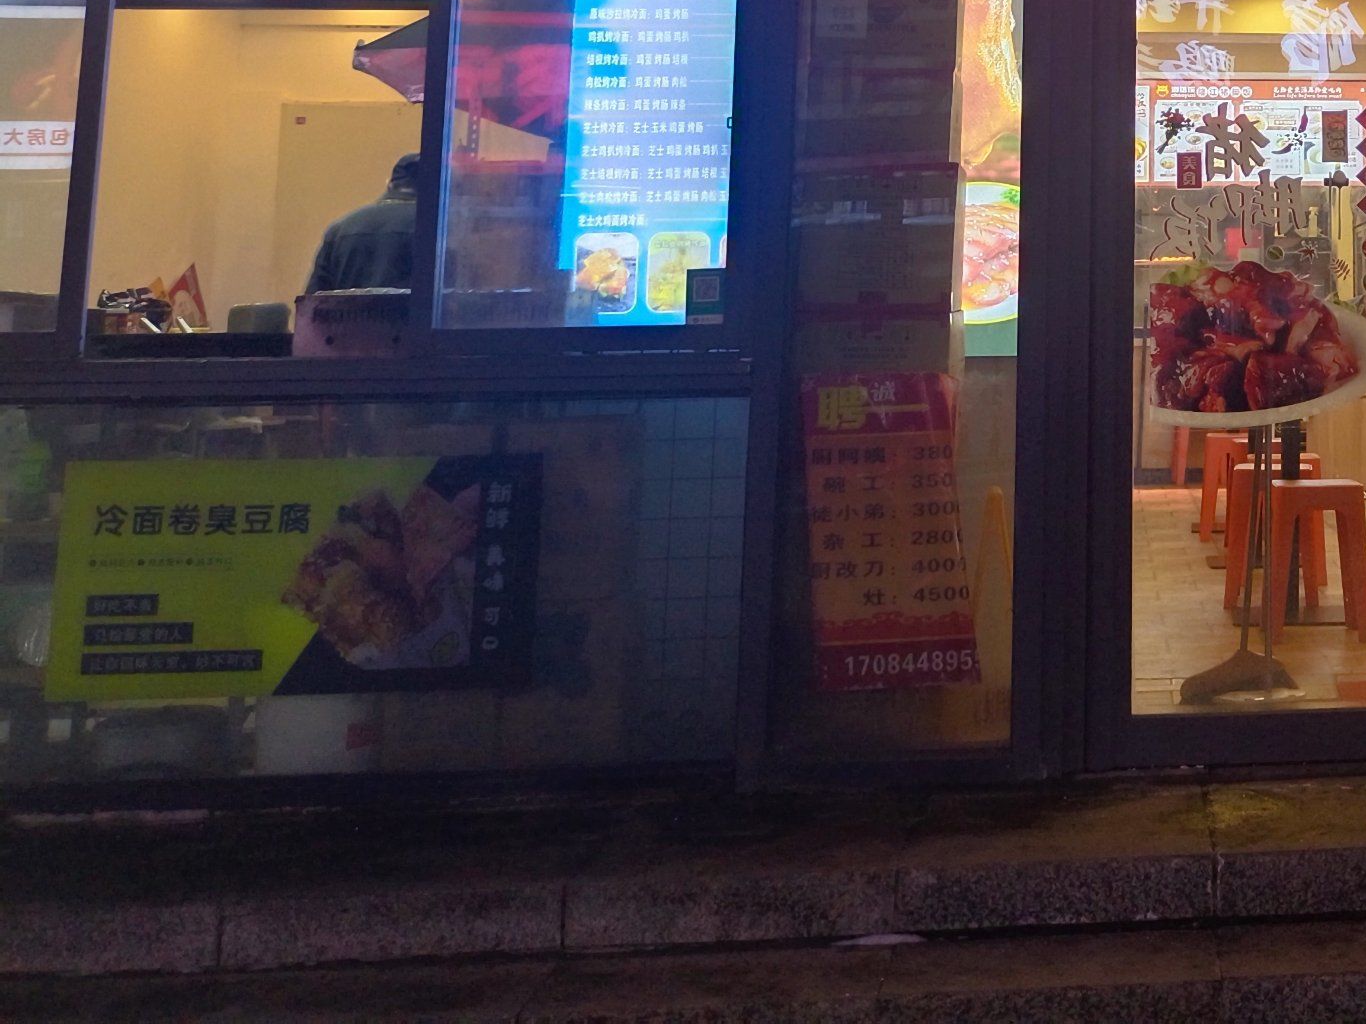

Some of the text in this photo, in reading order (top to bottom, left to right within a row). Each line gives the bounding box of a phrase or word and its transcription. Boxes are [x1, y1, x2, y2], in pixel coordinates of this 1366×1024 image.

[93, 502, 312, 537] 冷面卷臭豆腐
